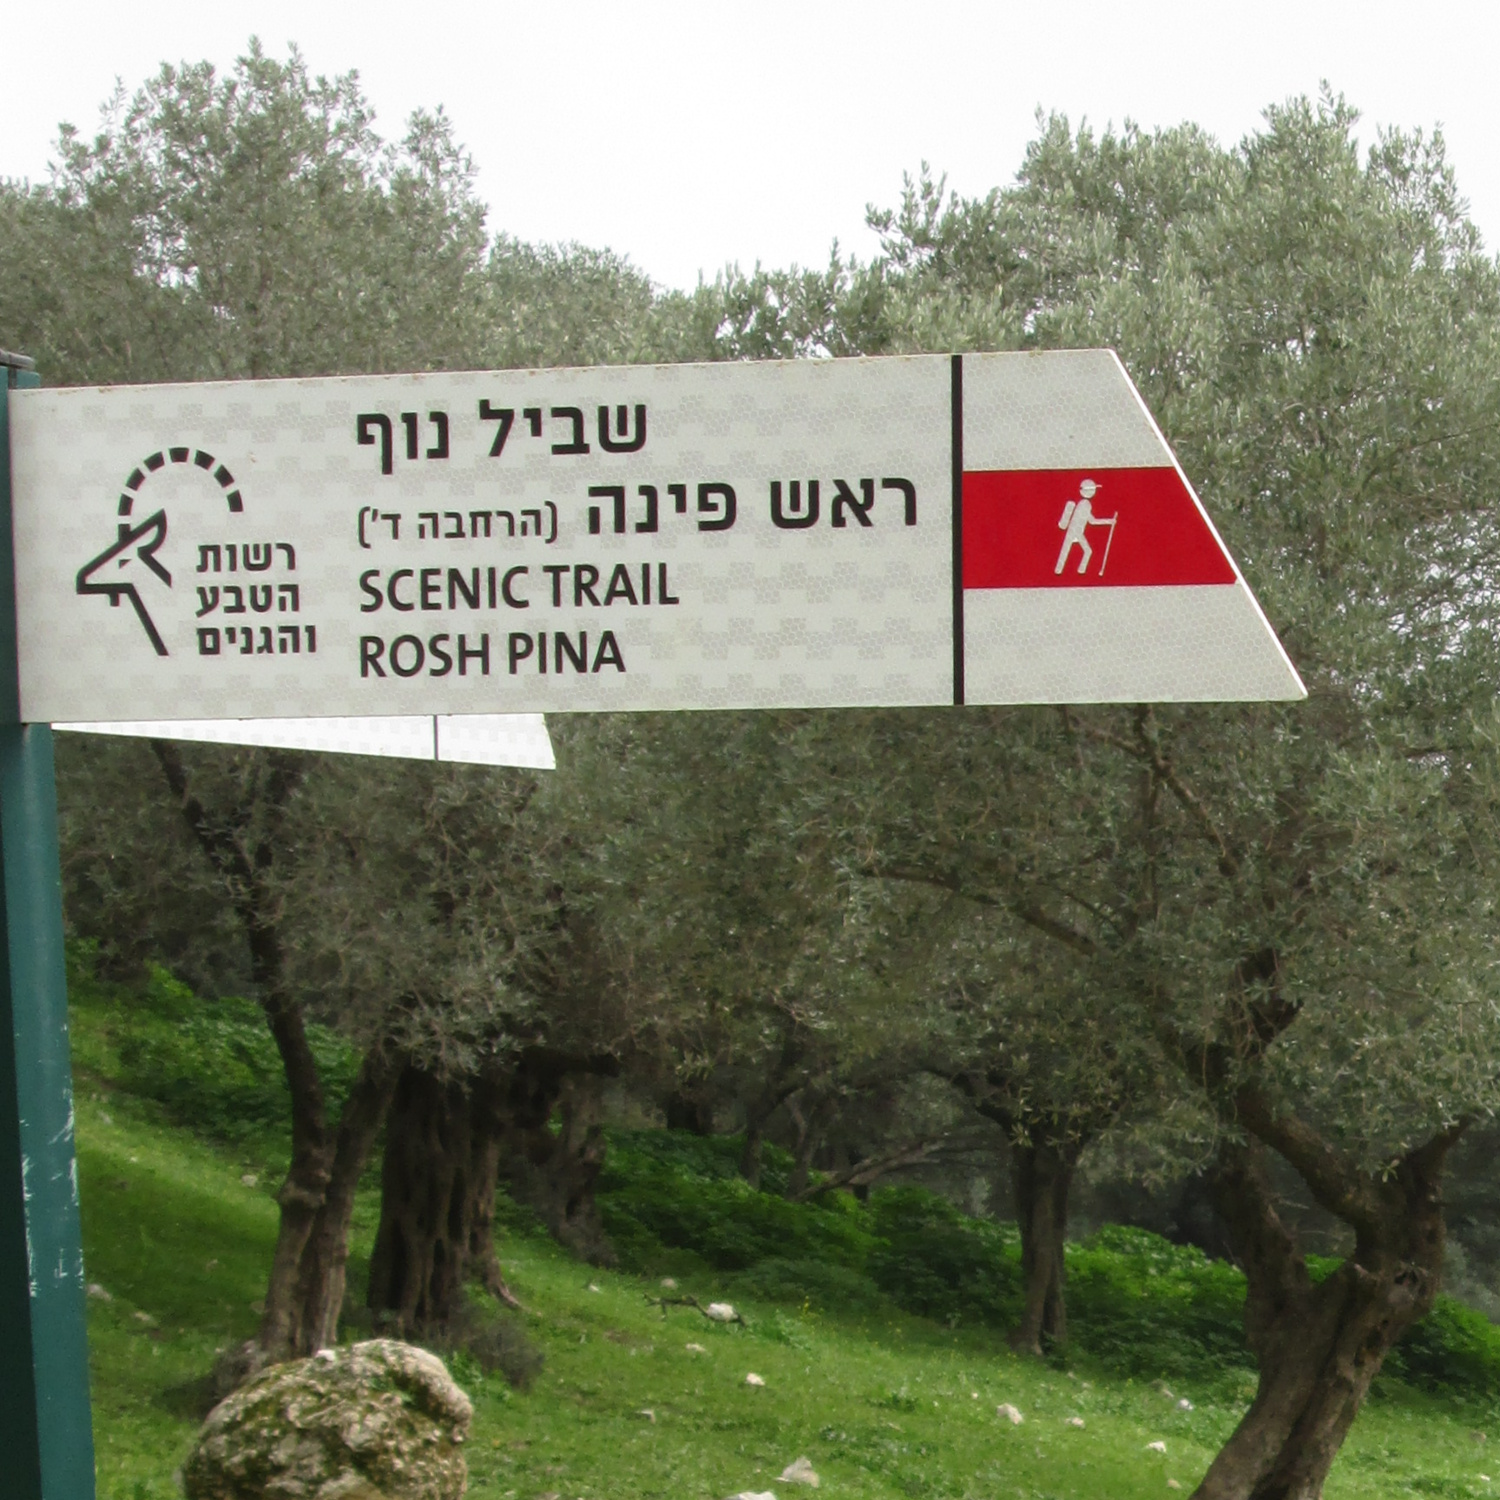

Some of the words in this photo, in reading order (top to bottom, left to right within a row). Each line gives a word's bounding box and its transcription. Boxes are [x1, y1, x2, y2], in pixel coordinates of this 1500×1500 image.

[356, 407, 451, 476] נוף
[479, 398, 648, 458] שביל
[357, 506, 403, 549] ד')
[417, 500, 559, 544] (הרחבה
[587, 482, 738, 536] פינה
[769, 477, 918, 531] ראש
[195, 542, 297, 573] רשות
[195, 583, 301, 618] הטבע
[358, 565, 531, 613] SCENIC
[542, 562, 681, 609] TRAIL
[195, 624, 318, 656] והגנים
[359, 633, 491, 678] ROSH
[507, 630, 627, 676] PINA
